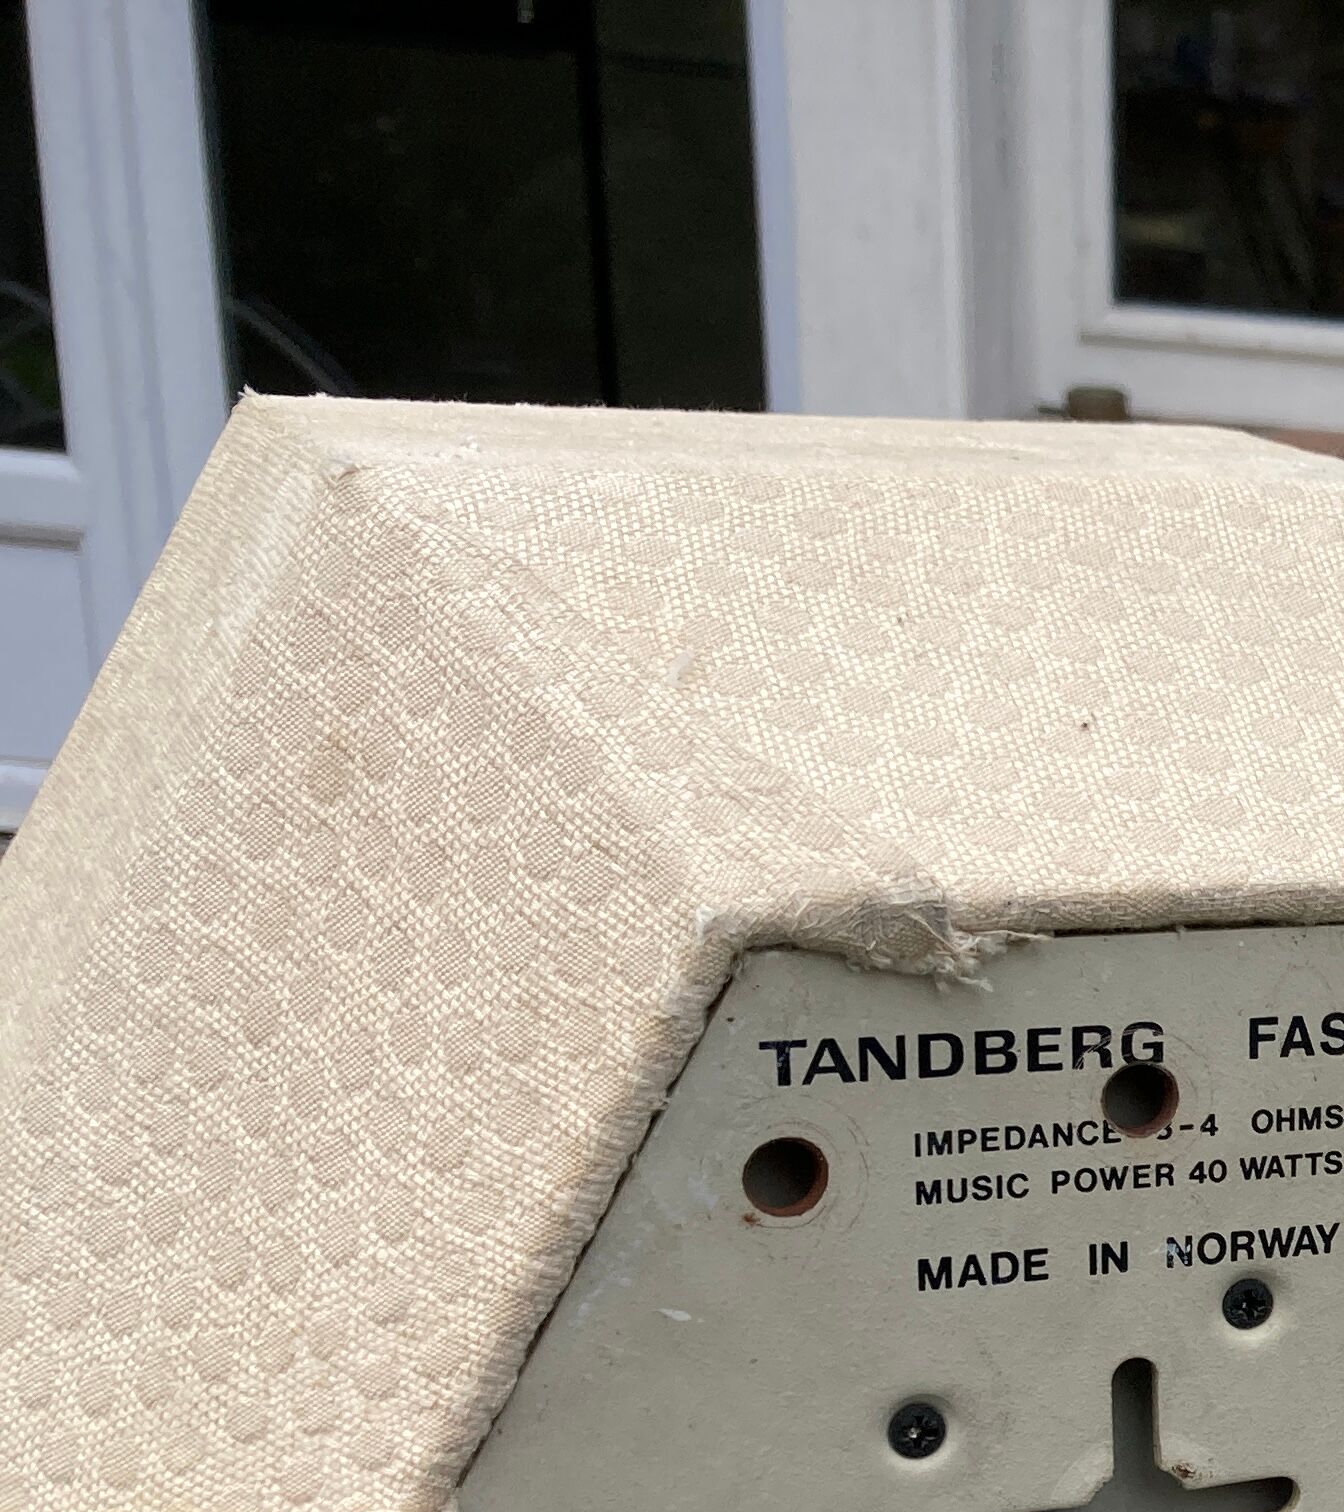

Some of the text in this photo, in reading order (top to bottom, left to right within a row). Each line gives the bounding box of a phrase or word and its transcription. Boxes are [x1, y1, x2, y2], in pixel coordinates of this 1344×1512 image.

[758, 1021, 1166, 1088] TANDBERG
[913, 1120, 1122, 1158] IMPEDANCE
[1250, 1105, 1344, 1134] OHMS
[914, 1150, 1344, 1206] MUSIC POWER 40 WATTS
[916, 1222, 1342, 1292] MADE IN NORWAY
